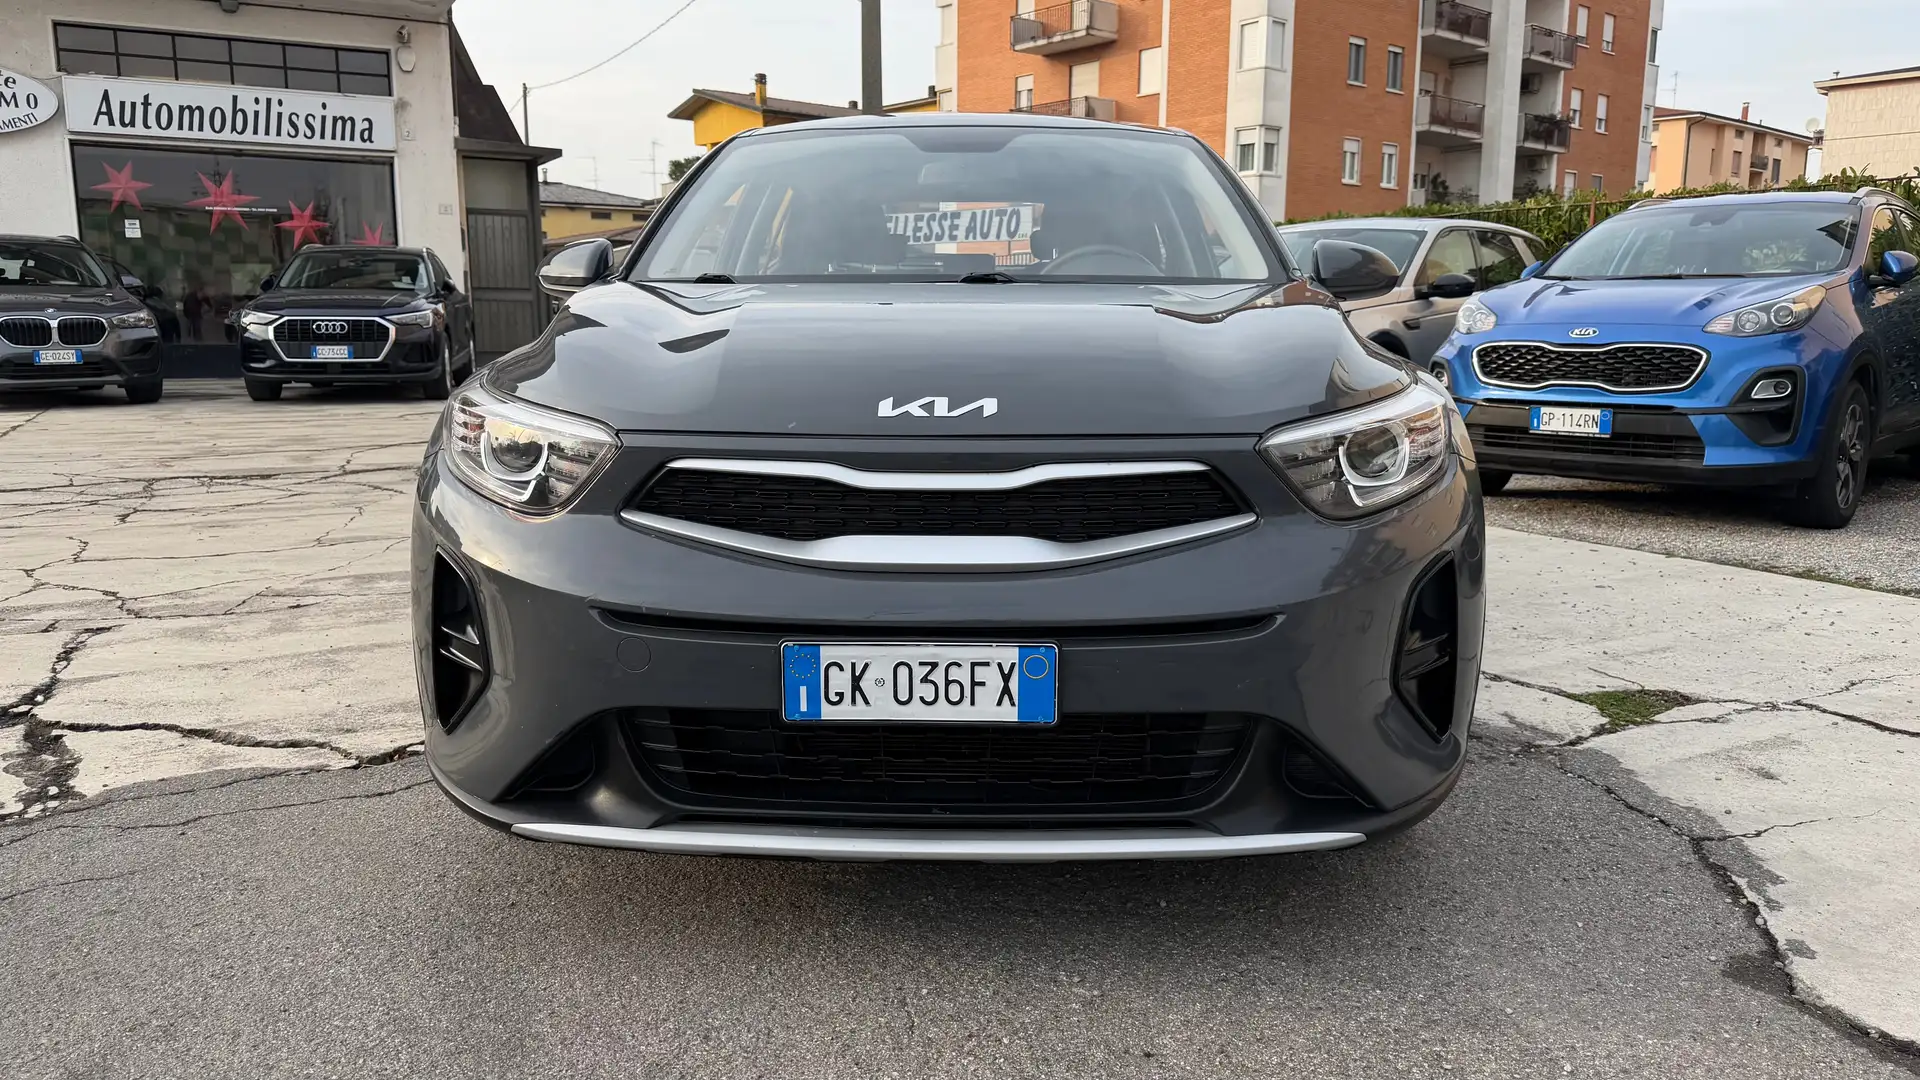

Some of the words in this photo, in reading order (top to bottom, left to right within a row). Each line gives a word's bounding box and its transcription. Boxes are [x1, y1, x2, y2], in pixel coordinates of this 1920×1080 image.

[93, 88, 375, 143] Automobilissima
[964, 207, 1021, 241] AUTO
[878, 396, 998, 418] KIA
[823, 660, 871, 707] GK
[892, 660, 1017, 707] 036FX
